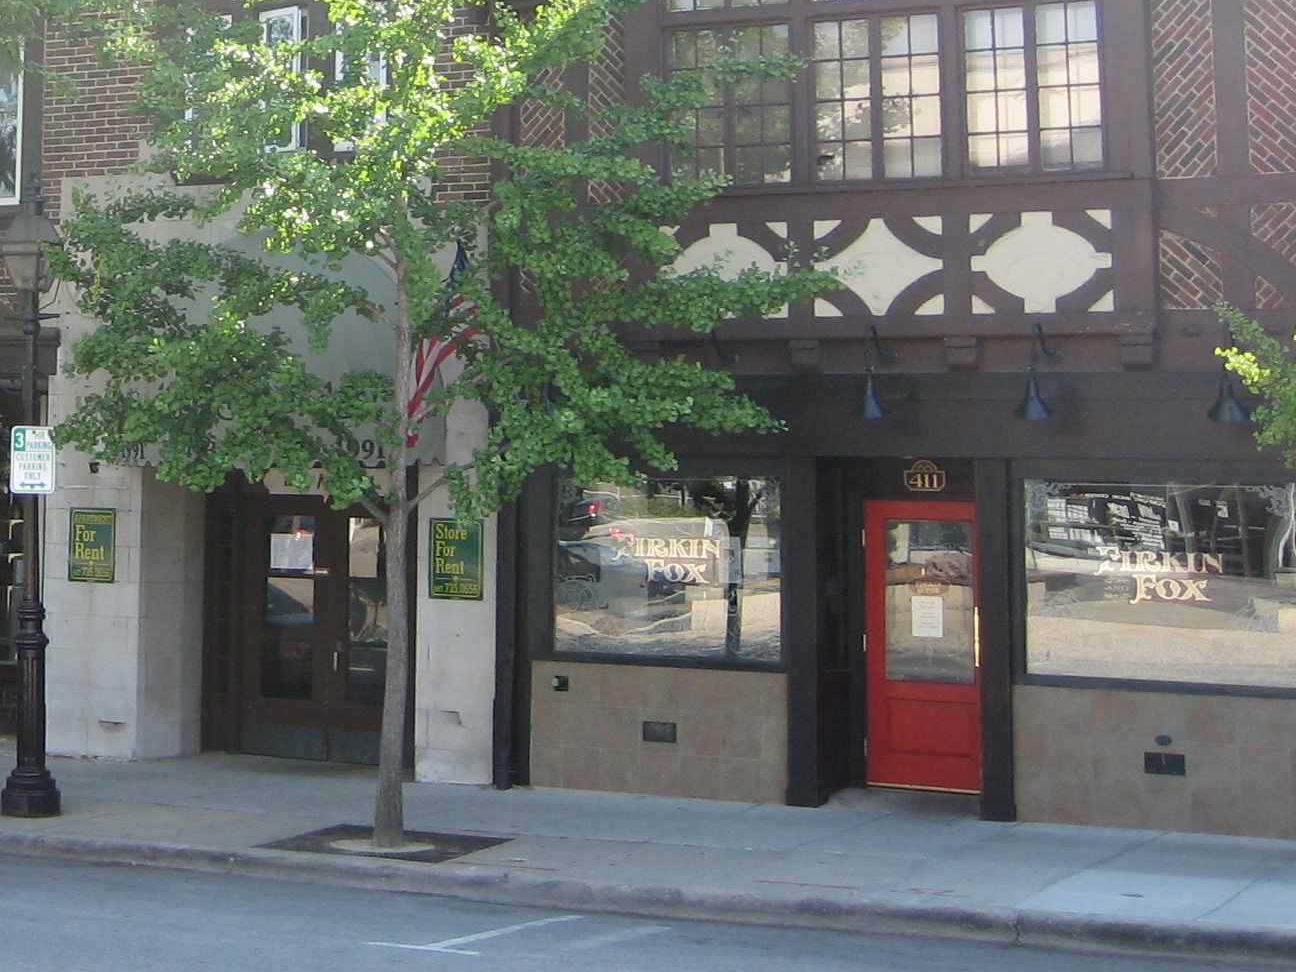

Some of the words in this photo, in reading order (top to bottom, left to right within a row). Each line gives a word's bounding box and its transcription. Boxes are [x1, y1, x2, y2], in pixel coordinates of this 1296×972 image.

[15, 432, 24, 448] 3
[27, 441, 53, 449] PARKING
[16, 453, 51, 462] CUSTOMER
[19, 463, 47, 471] PARKING
[24, 472, 41, 481] ONLY
[908, 473, 938, 489] 411
[75, 524, 96, 542] For
[436, 523, 468, 540] Store
[75, 542, 104, 560] Rent
[435, 541, 456, 557] For
[612, 535, 721, 561] FIRKIN
[435, 557, 464, 574] Rent
[1094, 546, 1224, 576] FIRKIN
[644, 558, 710, 584] FOX
[1129, 573, 1212, 605] FOX
